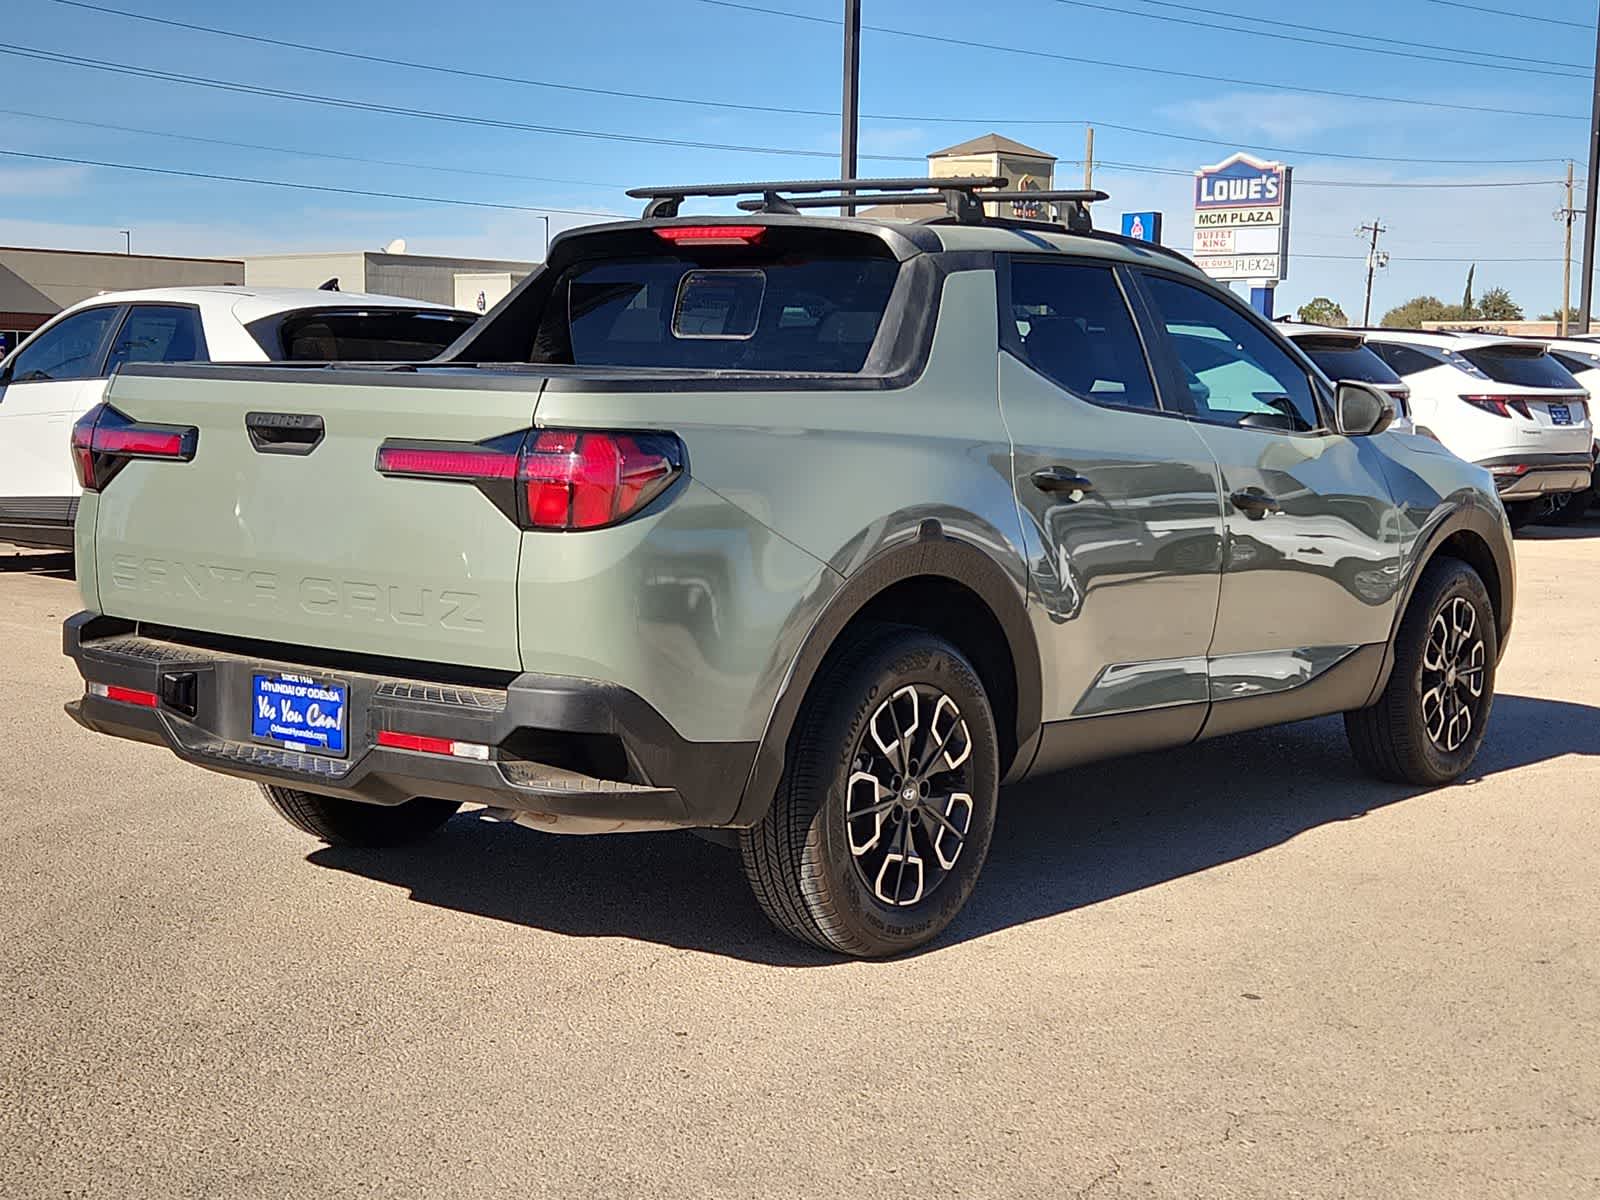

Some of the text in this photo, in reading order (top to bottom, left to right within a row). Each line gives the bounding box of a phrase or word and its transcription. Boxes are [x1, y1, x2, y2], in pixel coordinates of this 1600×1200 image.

[1201, 175, 1278, 201] LOWE'S
[1198, 211, 1274, 225] MCM PLAZA
[1196, 230, 1233, 240] BUFFET
[1202, 239, 1227, 248] KING
[1235, 257, 1275, 274] FLEX24
[111, 552, 486, 633] SANTA CRUZ
[261, 681, 339, 702] HYUNDAI OF ODESSA
[258, 695, 343, 730] Yes You Can!
